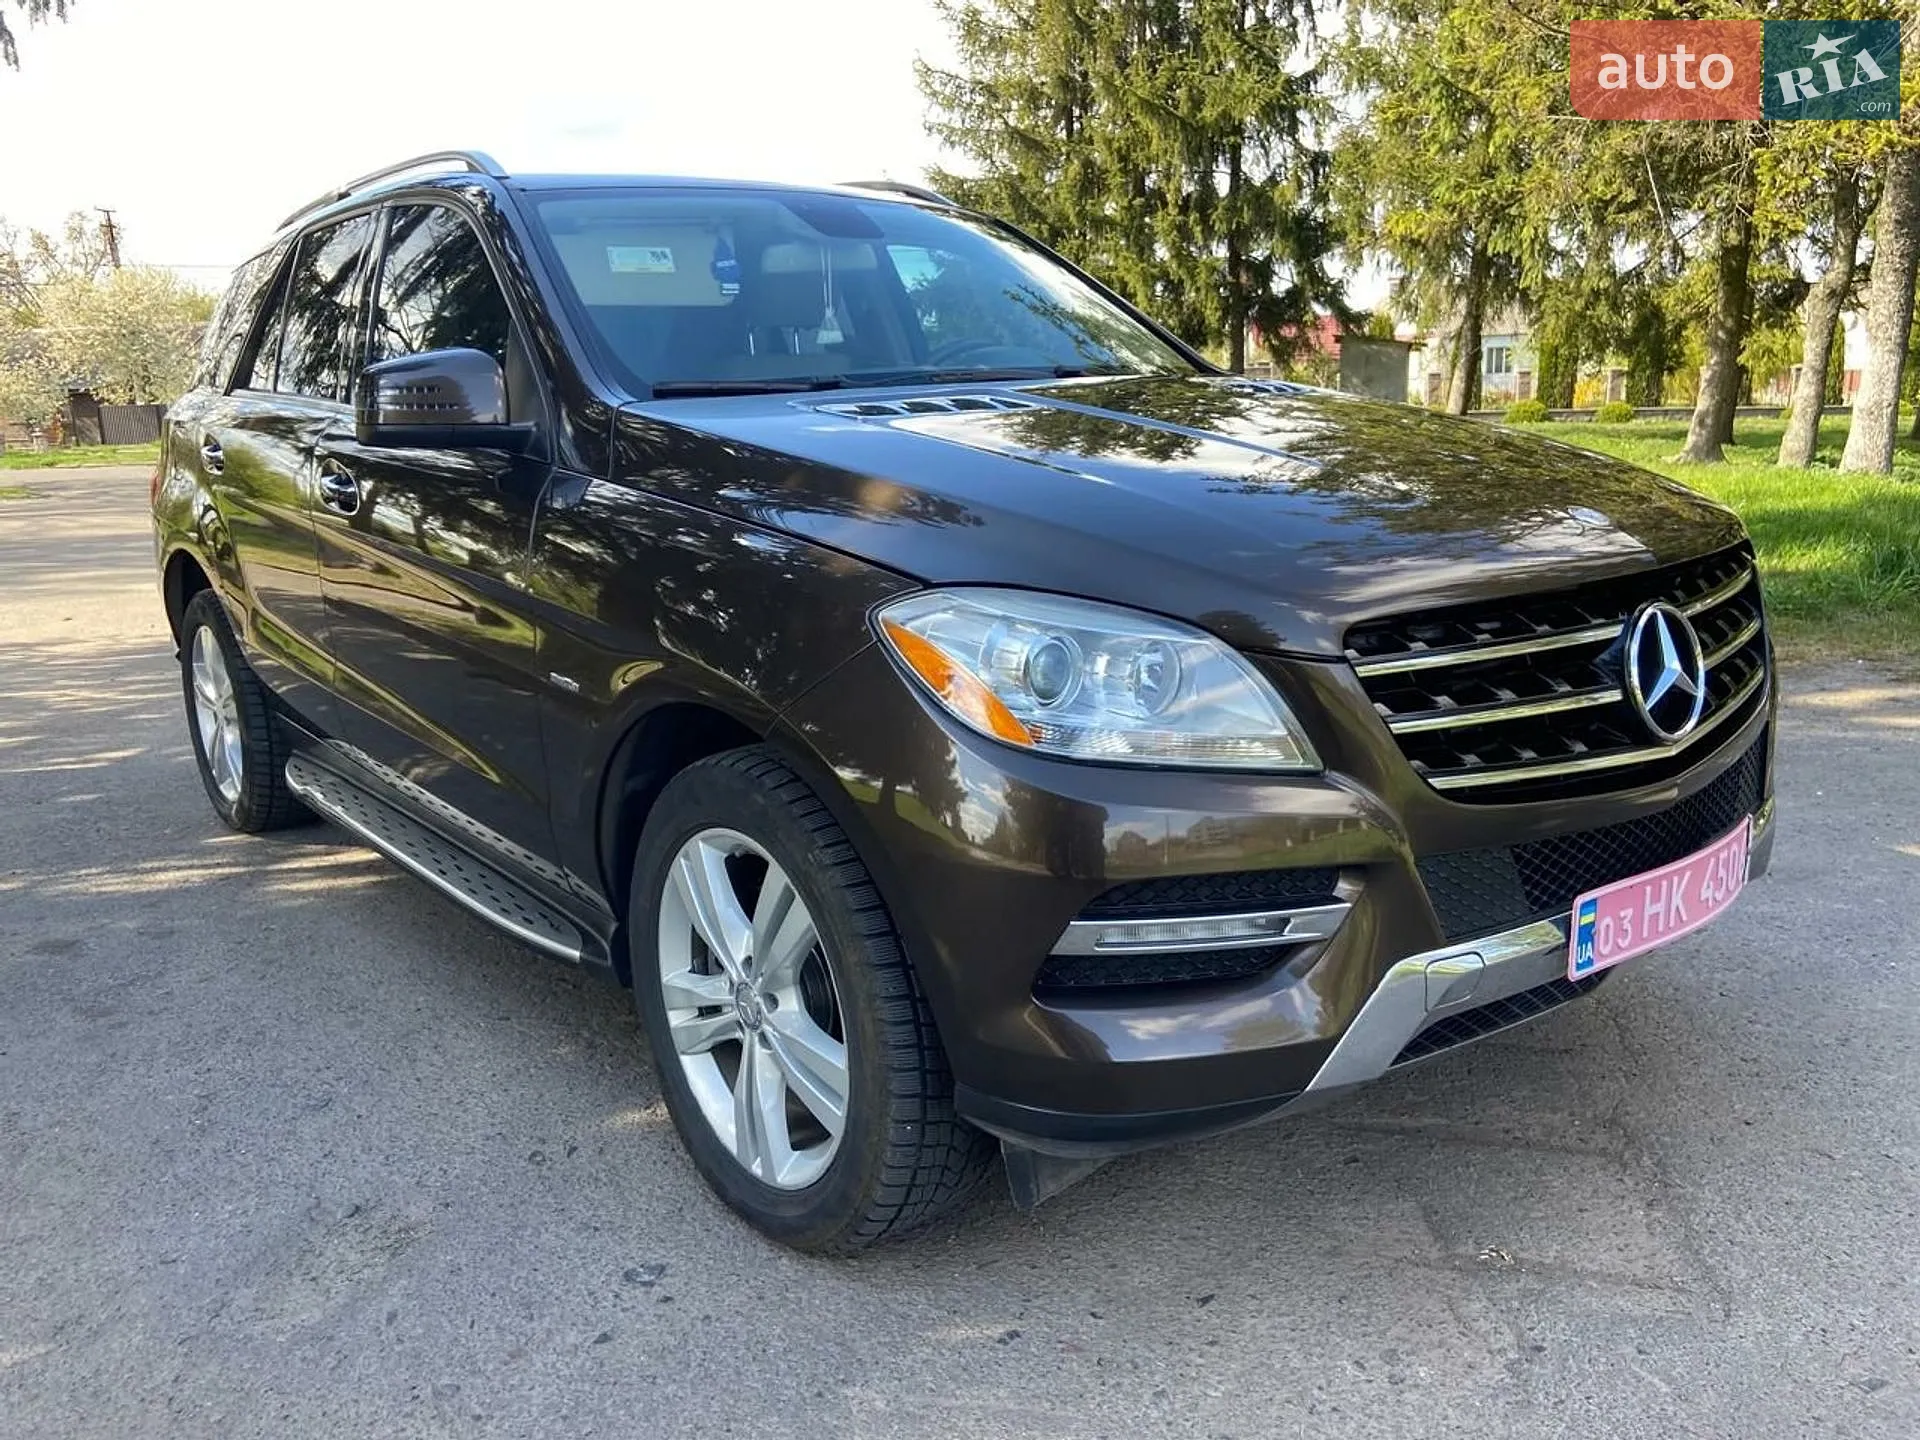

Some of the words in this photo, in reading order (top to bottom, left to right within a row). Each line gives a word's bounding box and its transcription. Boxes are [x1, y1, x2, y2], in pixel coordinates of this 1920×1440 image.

[1600, 908, 1633, 955] 03
[1642, 871, 1693, 939] HK
[1578, 941, 1593, 964] UA
